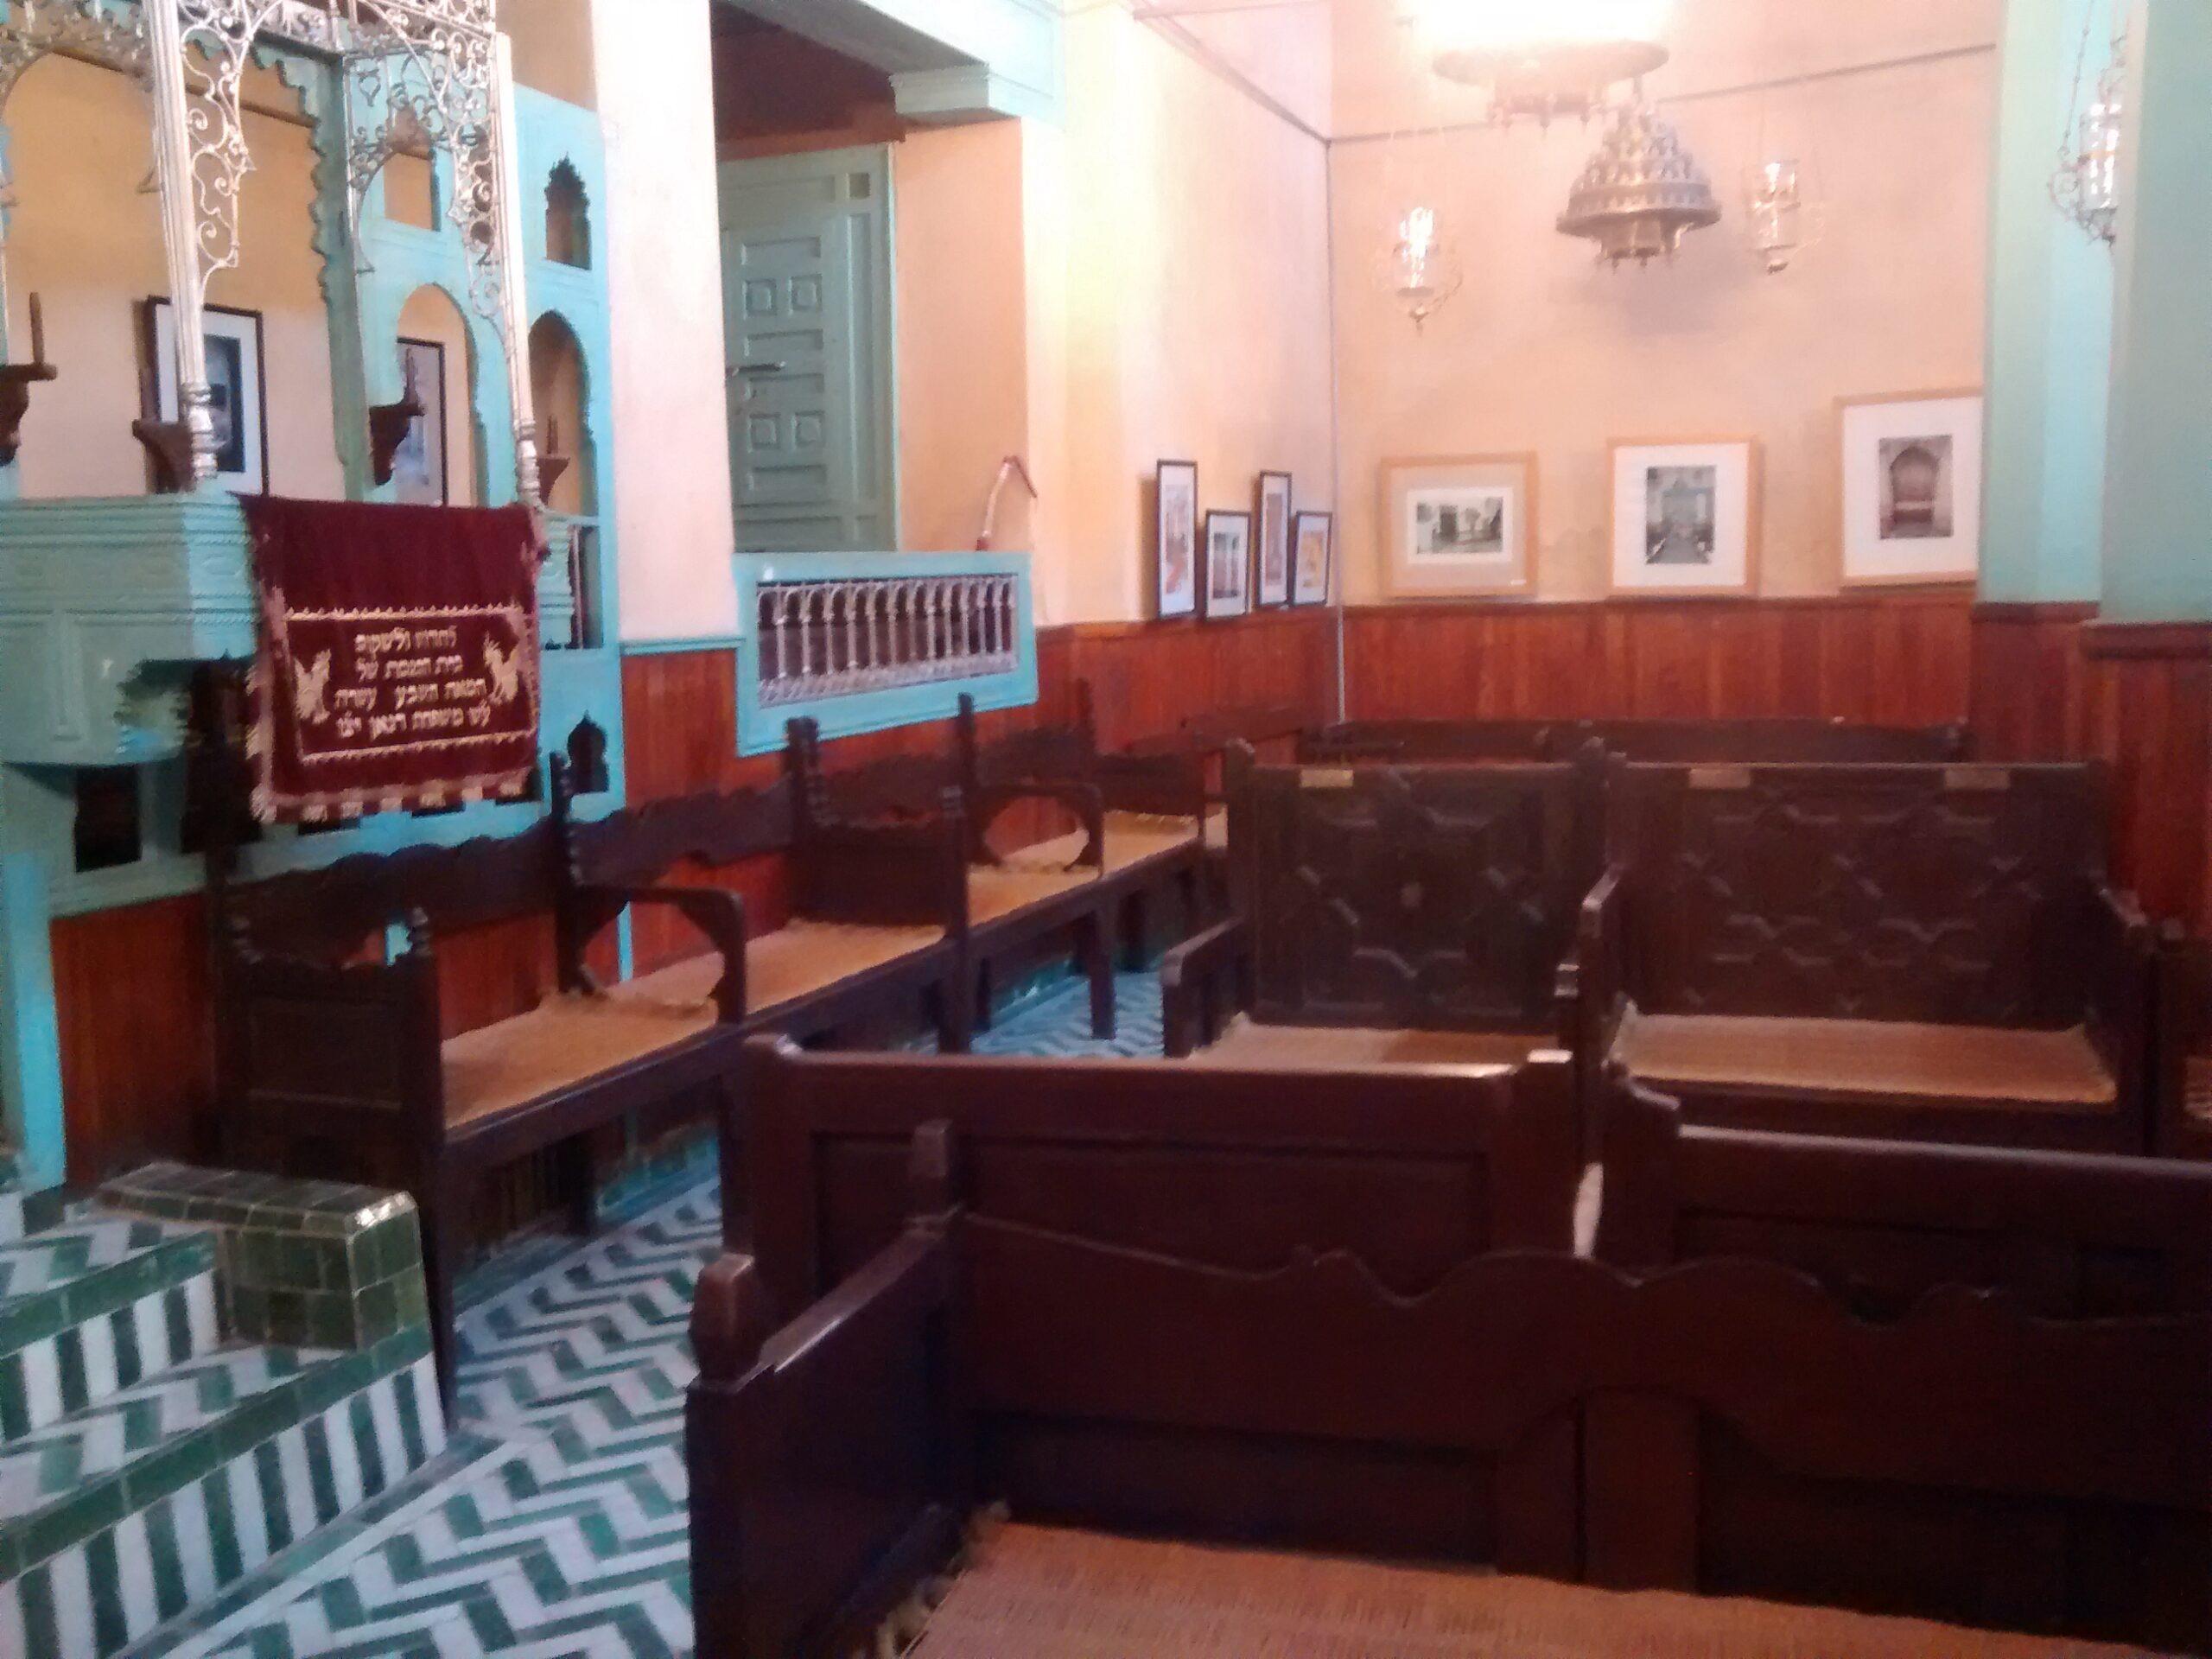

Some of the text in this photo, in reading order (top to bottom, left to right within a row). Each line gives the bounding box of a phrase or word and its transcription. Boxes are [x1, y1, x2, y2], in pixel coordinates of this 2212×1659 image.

[356, 655, 463, 682] בית הכנסת של
[369, 713, 407, 741] דנאן
[412, 708, 464, 730] משפחת
